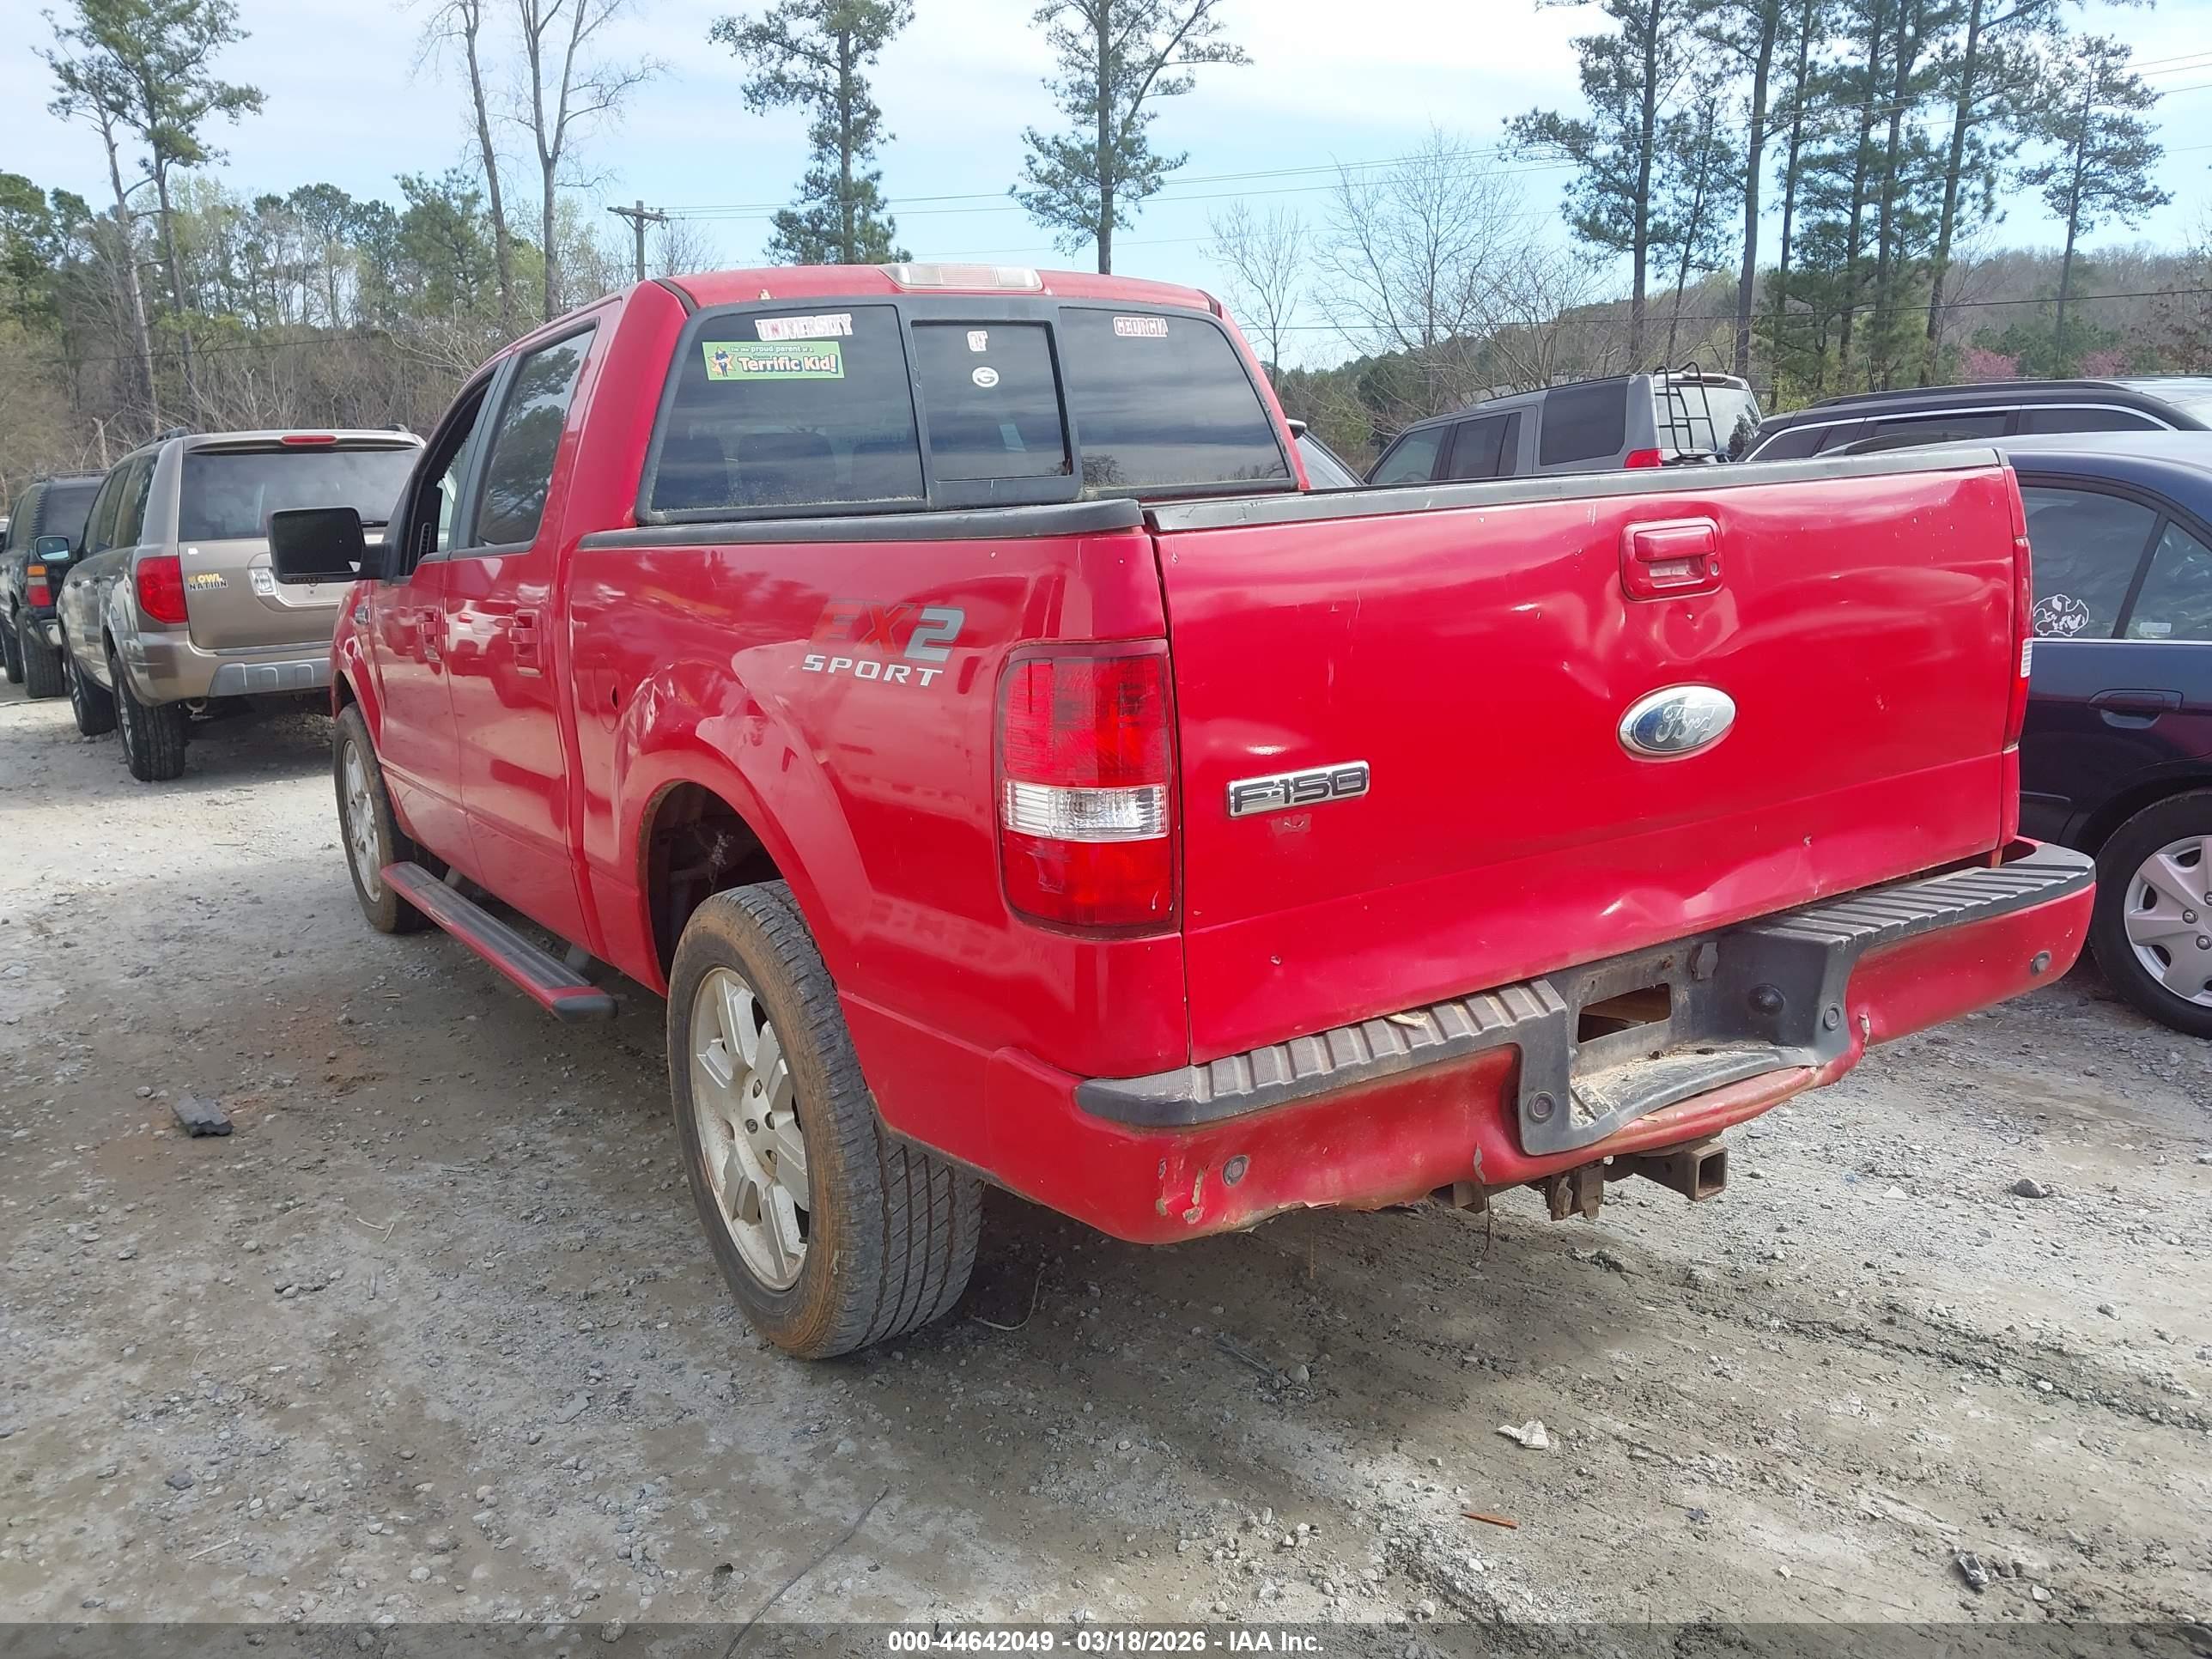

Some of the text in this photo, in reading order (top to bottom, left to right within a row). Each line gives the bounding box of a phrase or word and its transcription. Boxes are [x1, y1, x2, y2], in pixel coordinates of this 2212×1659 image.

[756, 313, 852, 340] UNIVERSITY
[1114, 317, 1168, 337] GEORGIA
[750, 345, 775, 355] proud
[775, 345, 801, 355] parent
[738, 354, 838, 374] Terrific Kid!
[189, 580, 228, 592] NATION
[802, 654, 943, 687] SPORT
[1655, 703, 1719, 743] Ford
[1233, 766, 1368, 813] F-150
